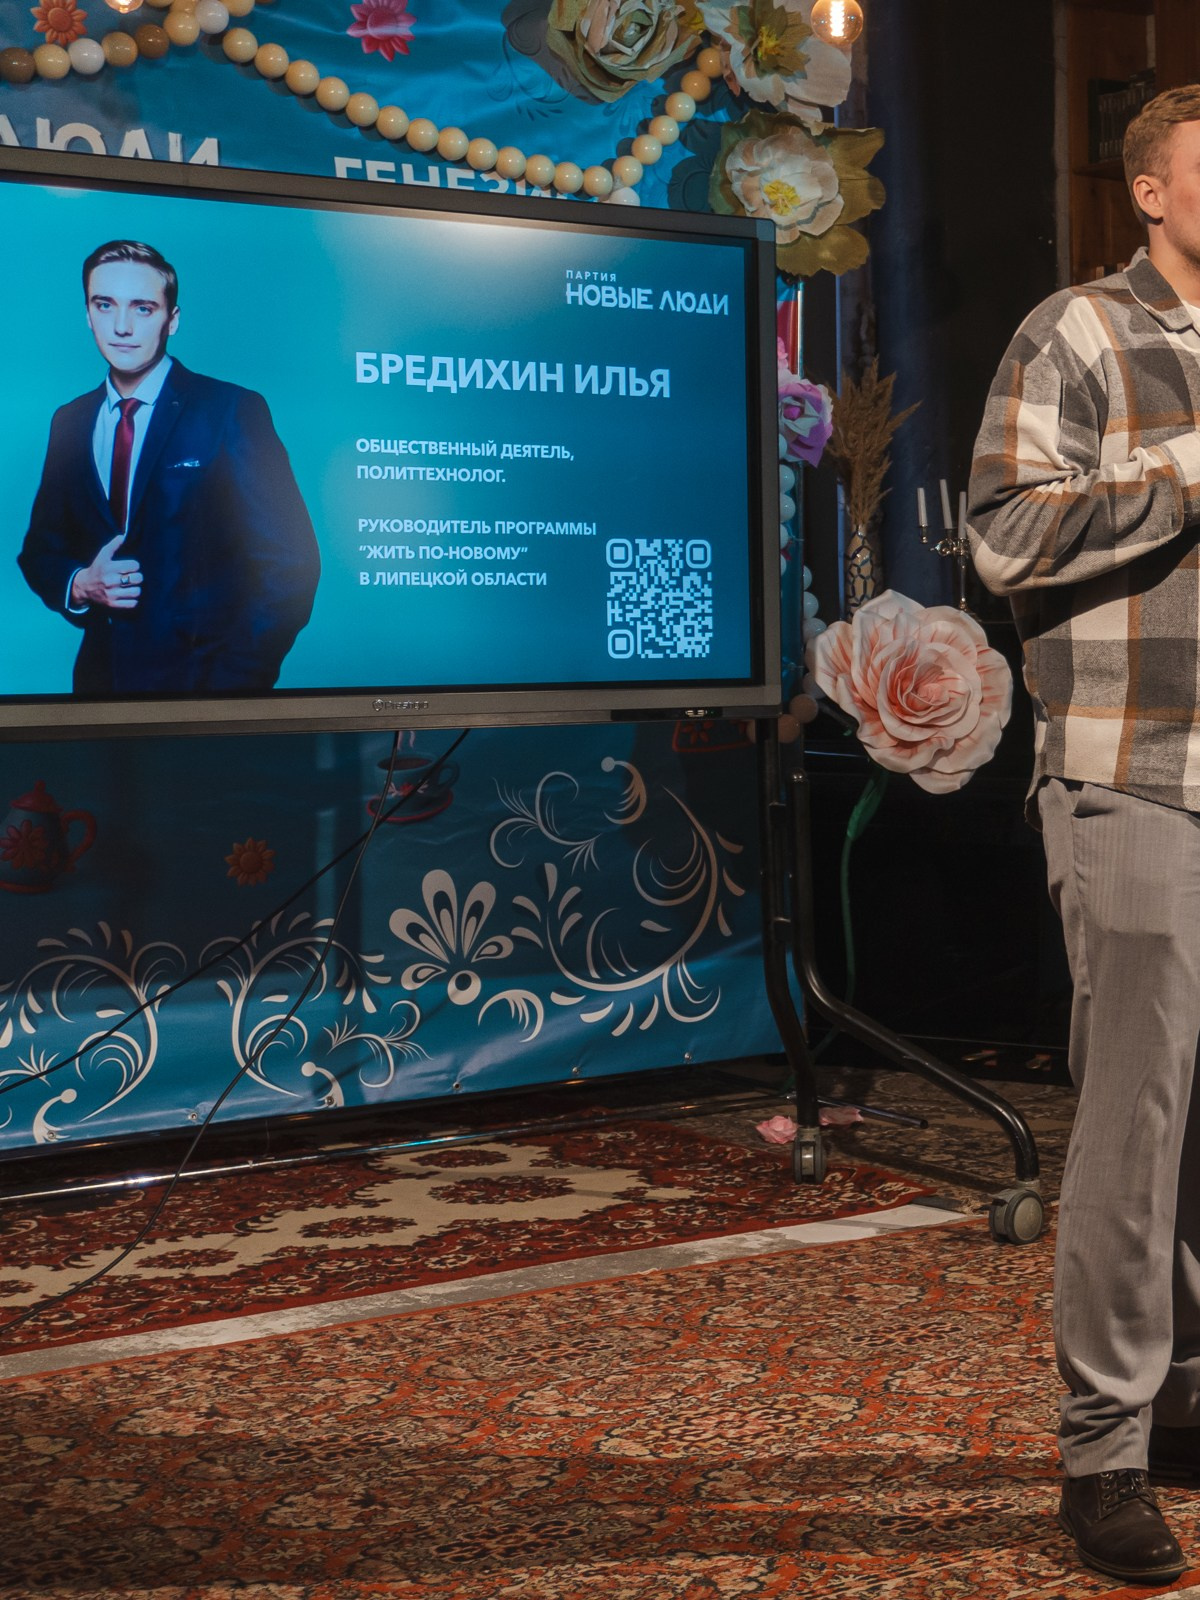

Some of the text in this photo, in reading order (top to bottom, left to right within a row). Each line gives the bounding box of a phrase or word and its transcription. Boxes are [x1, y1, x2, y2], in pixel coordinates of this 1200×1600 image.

[566, 270, 616, 282] ПАРТИЯ
[566, 283, 729, 316] НОВЫЕ ЛЮДИ
[355, 352, 671, 398] БРЕДИХИН ИЛЬЯ
[355, 438, 575, 461] ОБЩЕСТВЕННЫЙ ДЕЯТЕЛЬ,
[356, 465, 506, 483] ПОЛИТТЕХНОЛОГ.
[358, 518, 597, 536] РУКОВОДИТЕЛЬ ПРОГРАММЫ
[359, 569, 547, 588] В ЛИПЕЦКОЙ ОБЛАСТИ
